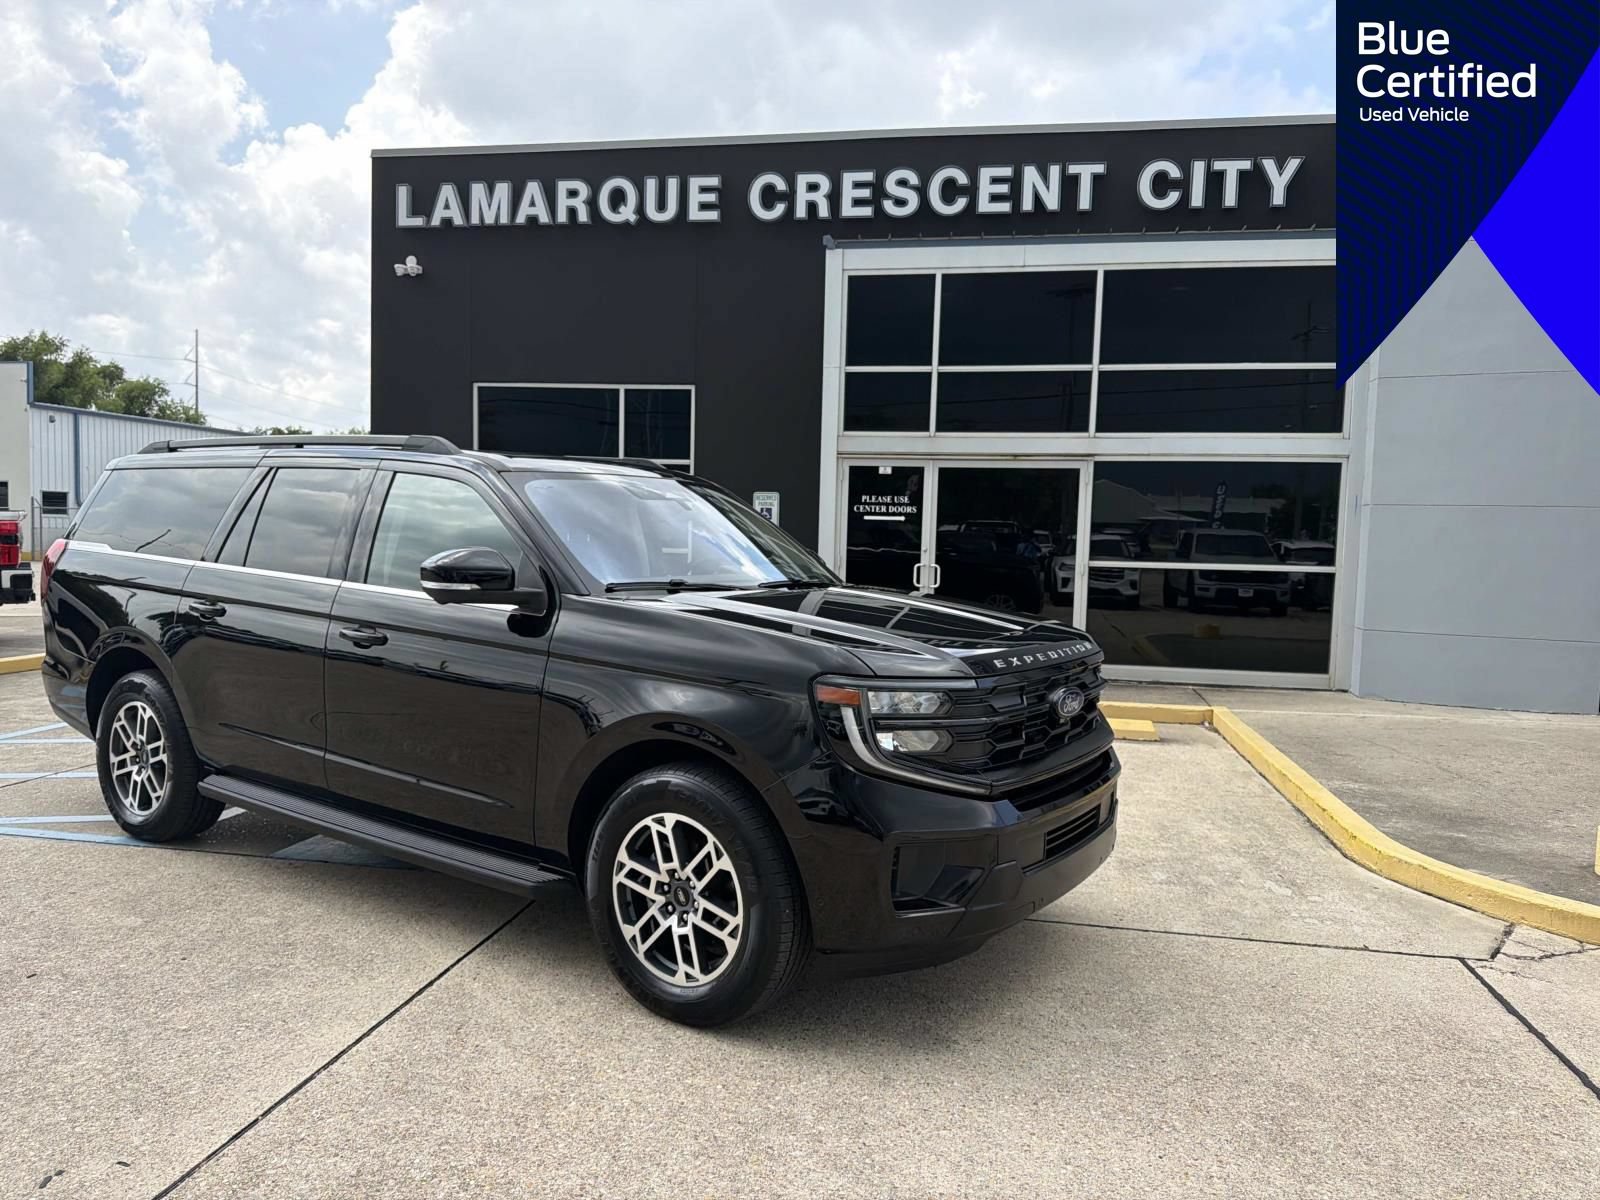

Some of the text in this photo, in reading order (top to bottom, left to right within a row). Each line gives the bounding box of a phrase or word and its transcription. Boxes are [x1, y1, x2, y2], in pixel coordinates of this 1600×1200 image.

[395, 155, 1305, 229] LAMARQUE CRESCENT CITY
[853, 504, 918, 514] CENTER DOORS
[861, 495, 910, 504] PLEASE USE
[993, 641, 1093, 669] EXPEDITION
[1063, 694, 1081, 713] Ford
